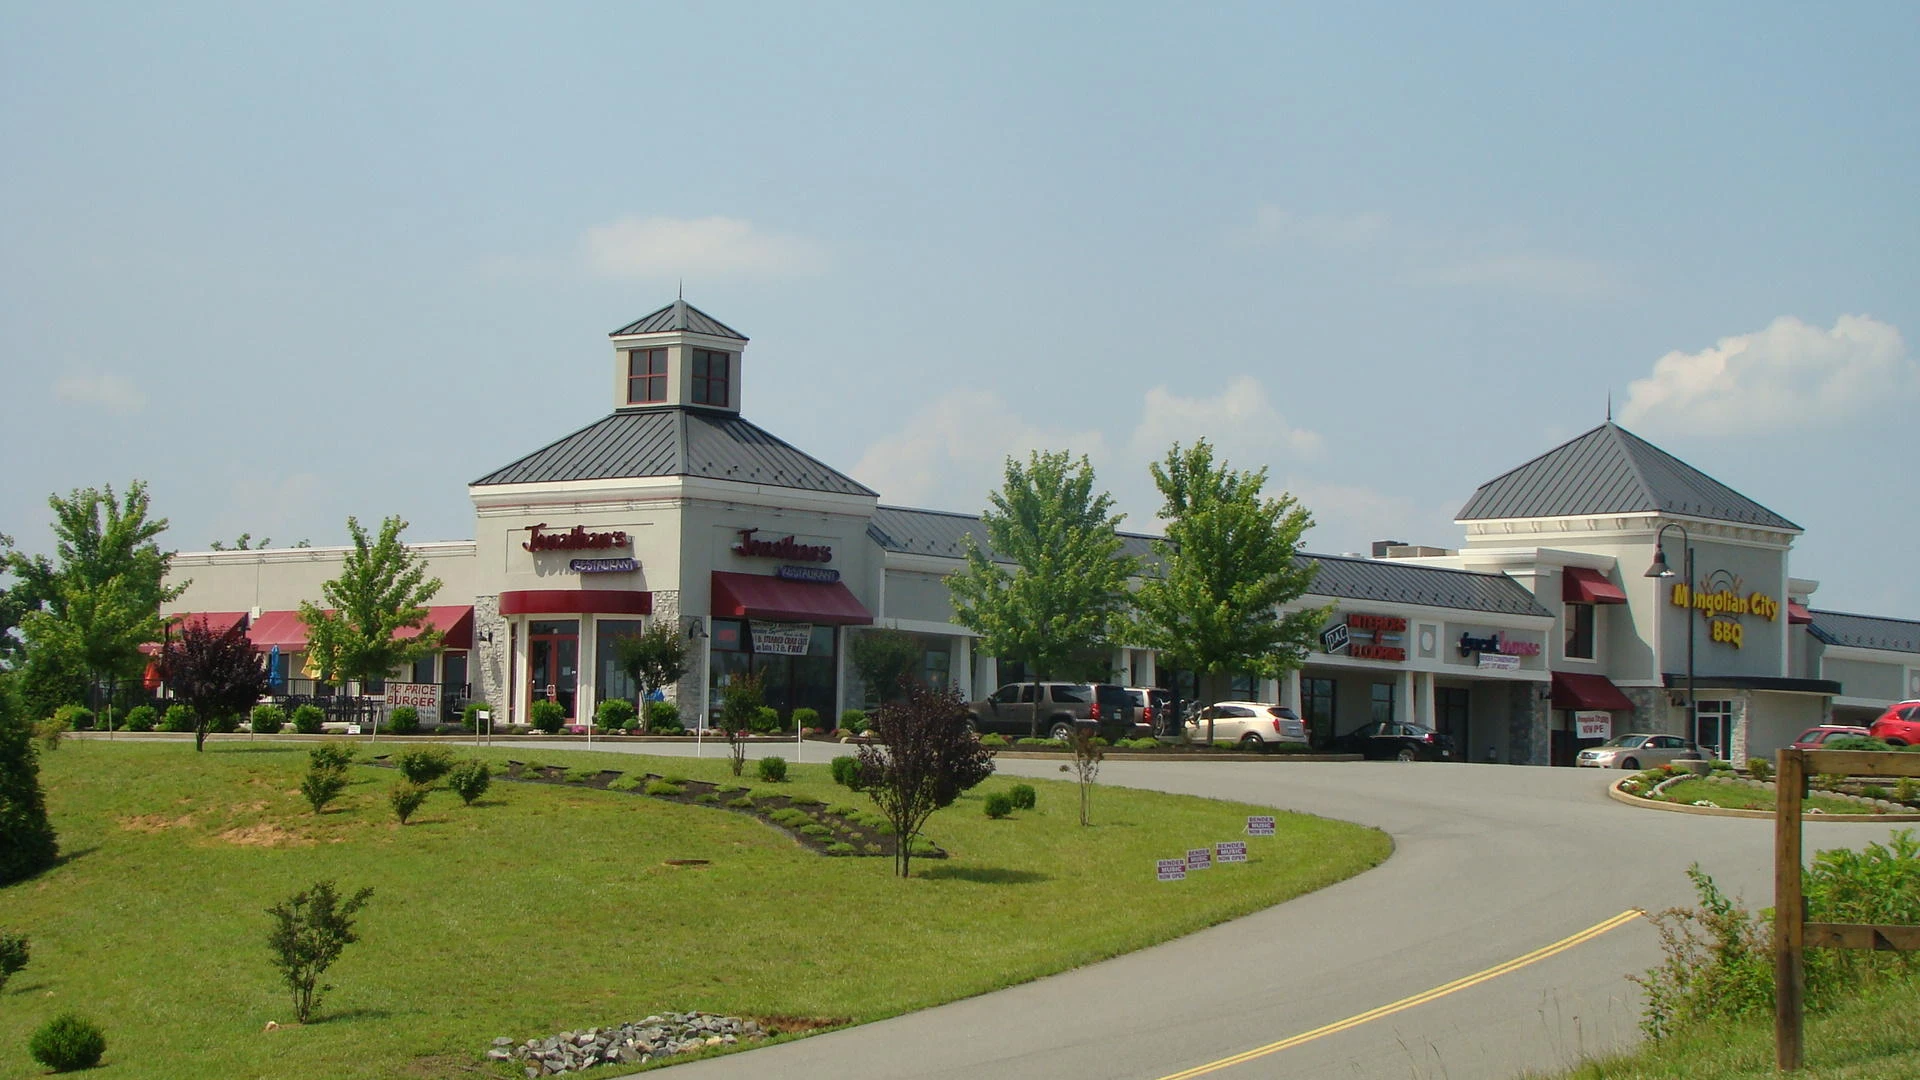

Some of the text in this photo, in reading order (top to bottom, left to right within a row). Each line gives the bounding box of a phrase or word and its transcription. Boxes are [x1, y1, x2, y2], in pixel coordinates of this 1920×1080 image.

[573, 560, 633, 572] RESTAURANT
[1671, 583, 1778, 621] Mngolian City
[1712, 620, 1743, 649] BBQ
[405, 685, 436, 695] PRICE
[387, 696, 435, 707] BURGER
